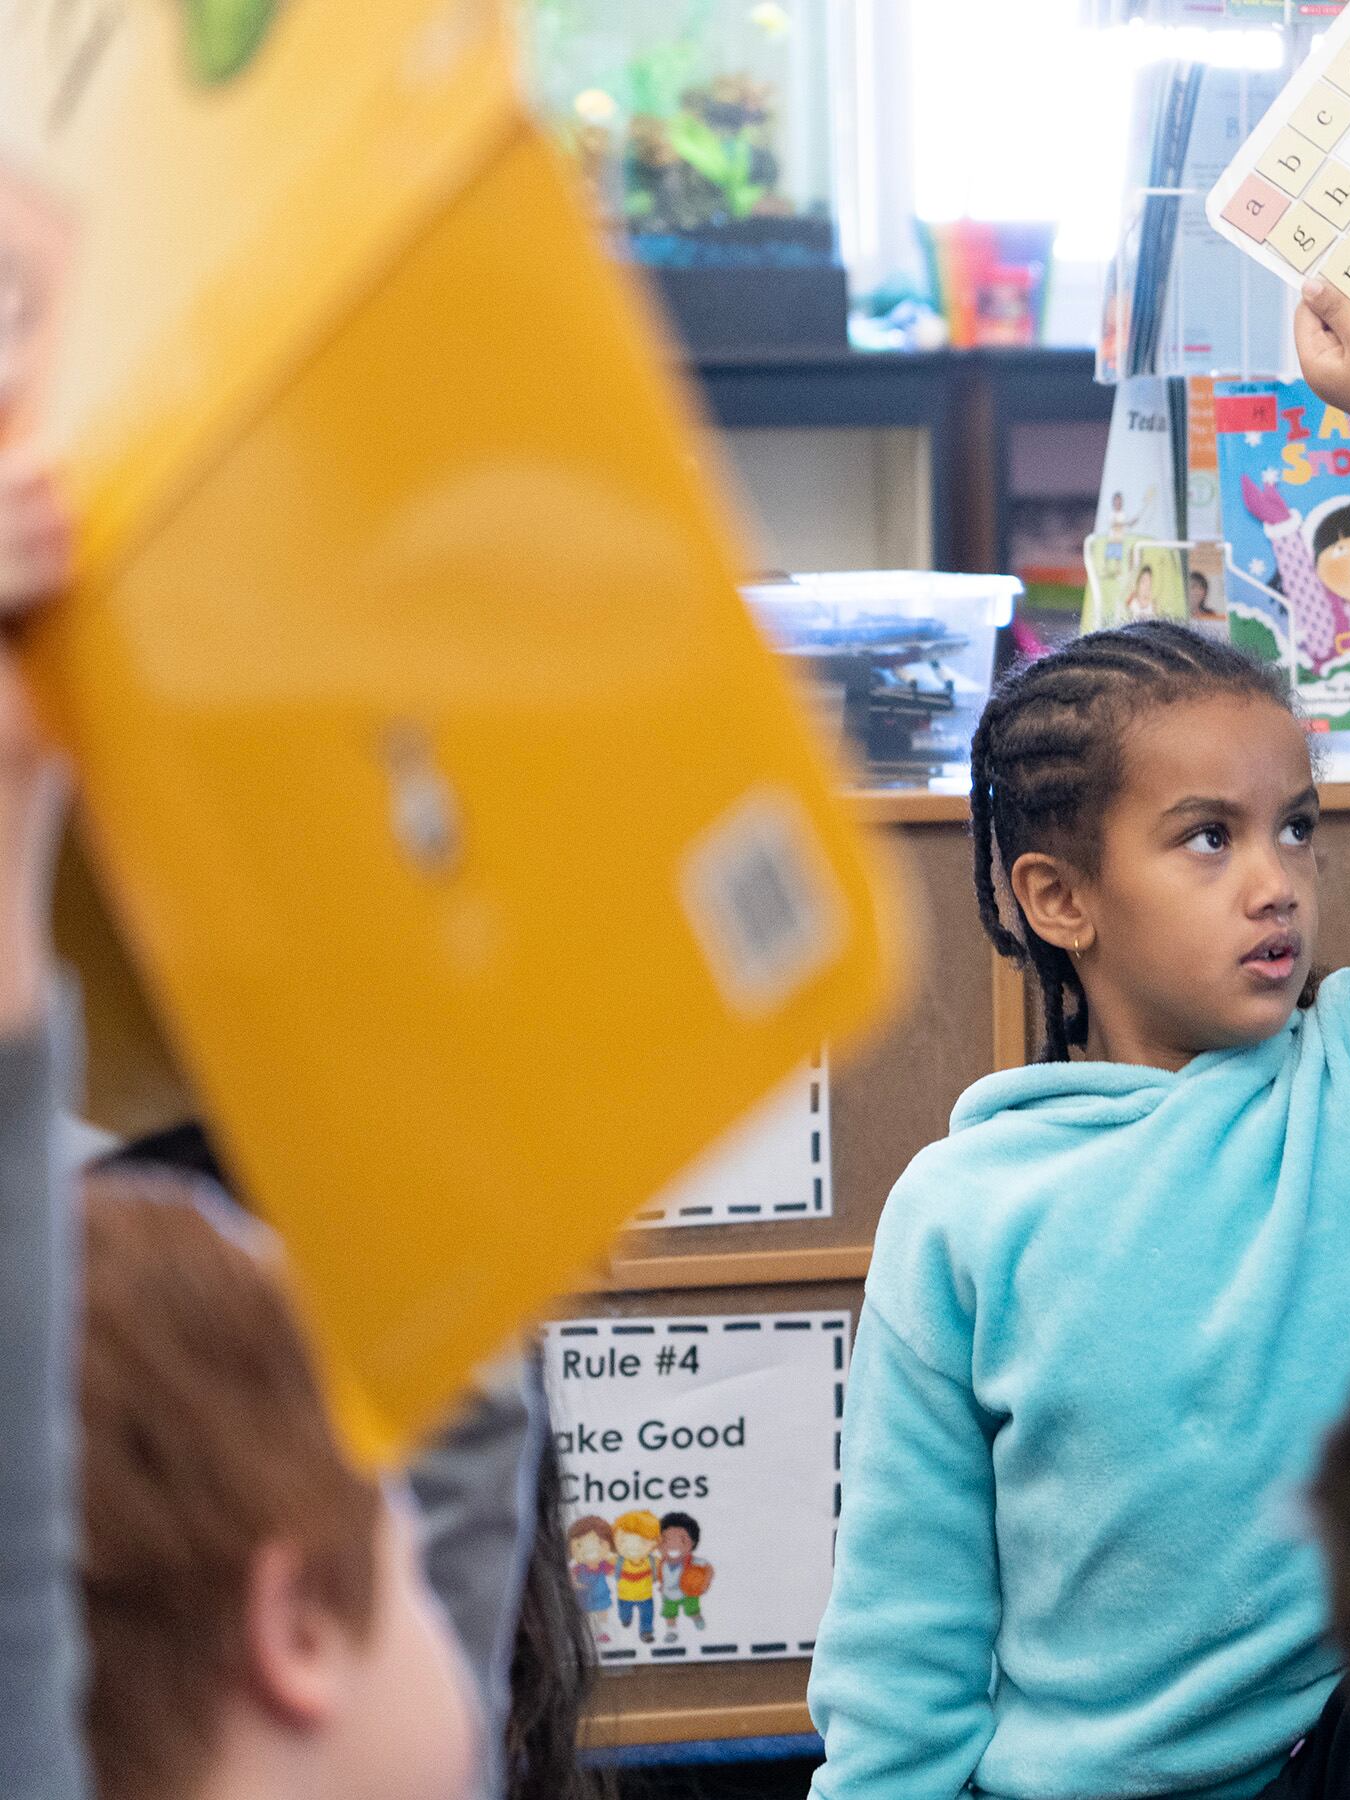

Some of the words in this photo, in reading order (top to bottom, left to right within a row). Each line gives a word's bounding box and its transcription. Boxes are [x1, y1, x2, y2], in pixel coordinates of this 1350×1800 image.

[1245, 199, 1265, 217] a
[1277, 154, 1302, 173] b
[1316, 110, 1333, 126] c
[1292, 224, 1316, 253] g
[1324, 187, 1350, 207] h
[1280, 406, 1311, 440] I
[562, 1347, 642, 1380] Rule
[655, 1344, 700, 1375] #4
[554, 1423, 624, 1454] ake
[637, 1416, 746, 1451] Good
[560, 1470, 709, 1504] Choices
